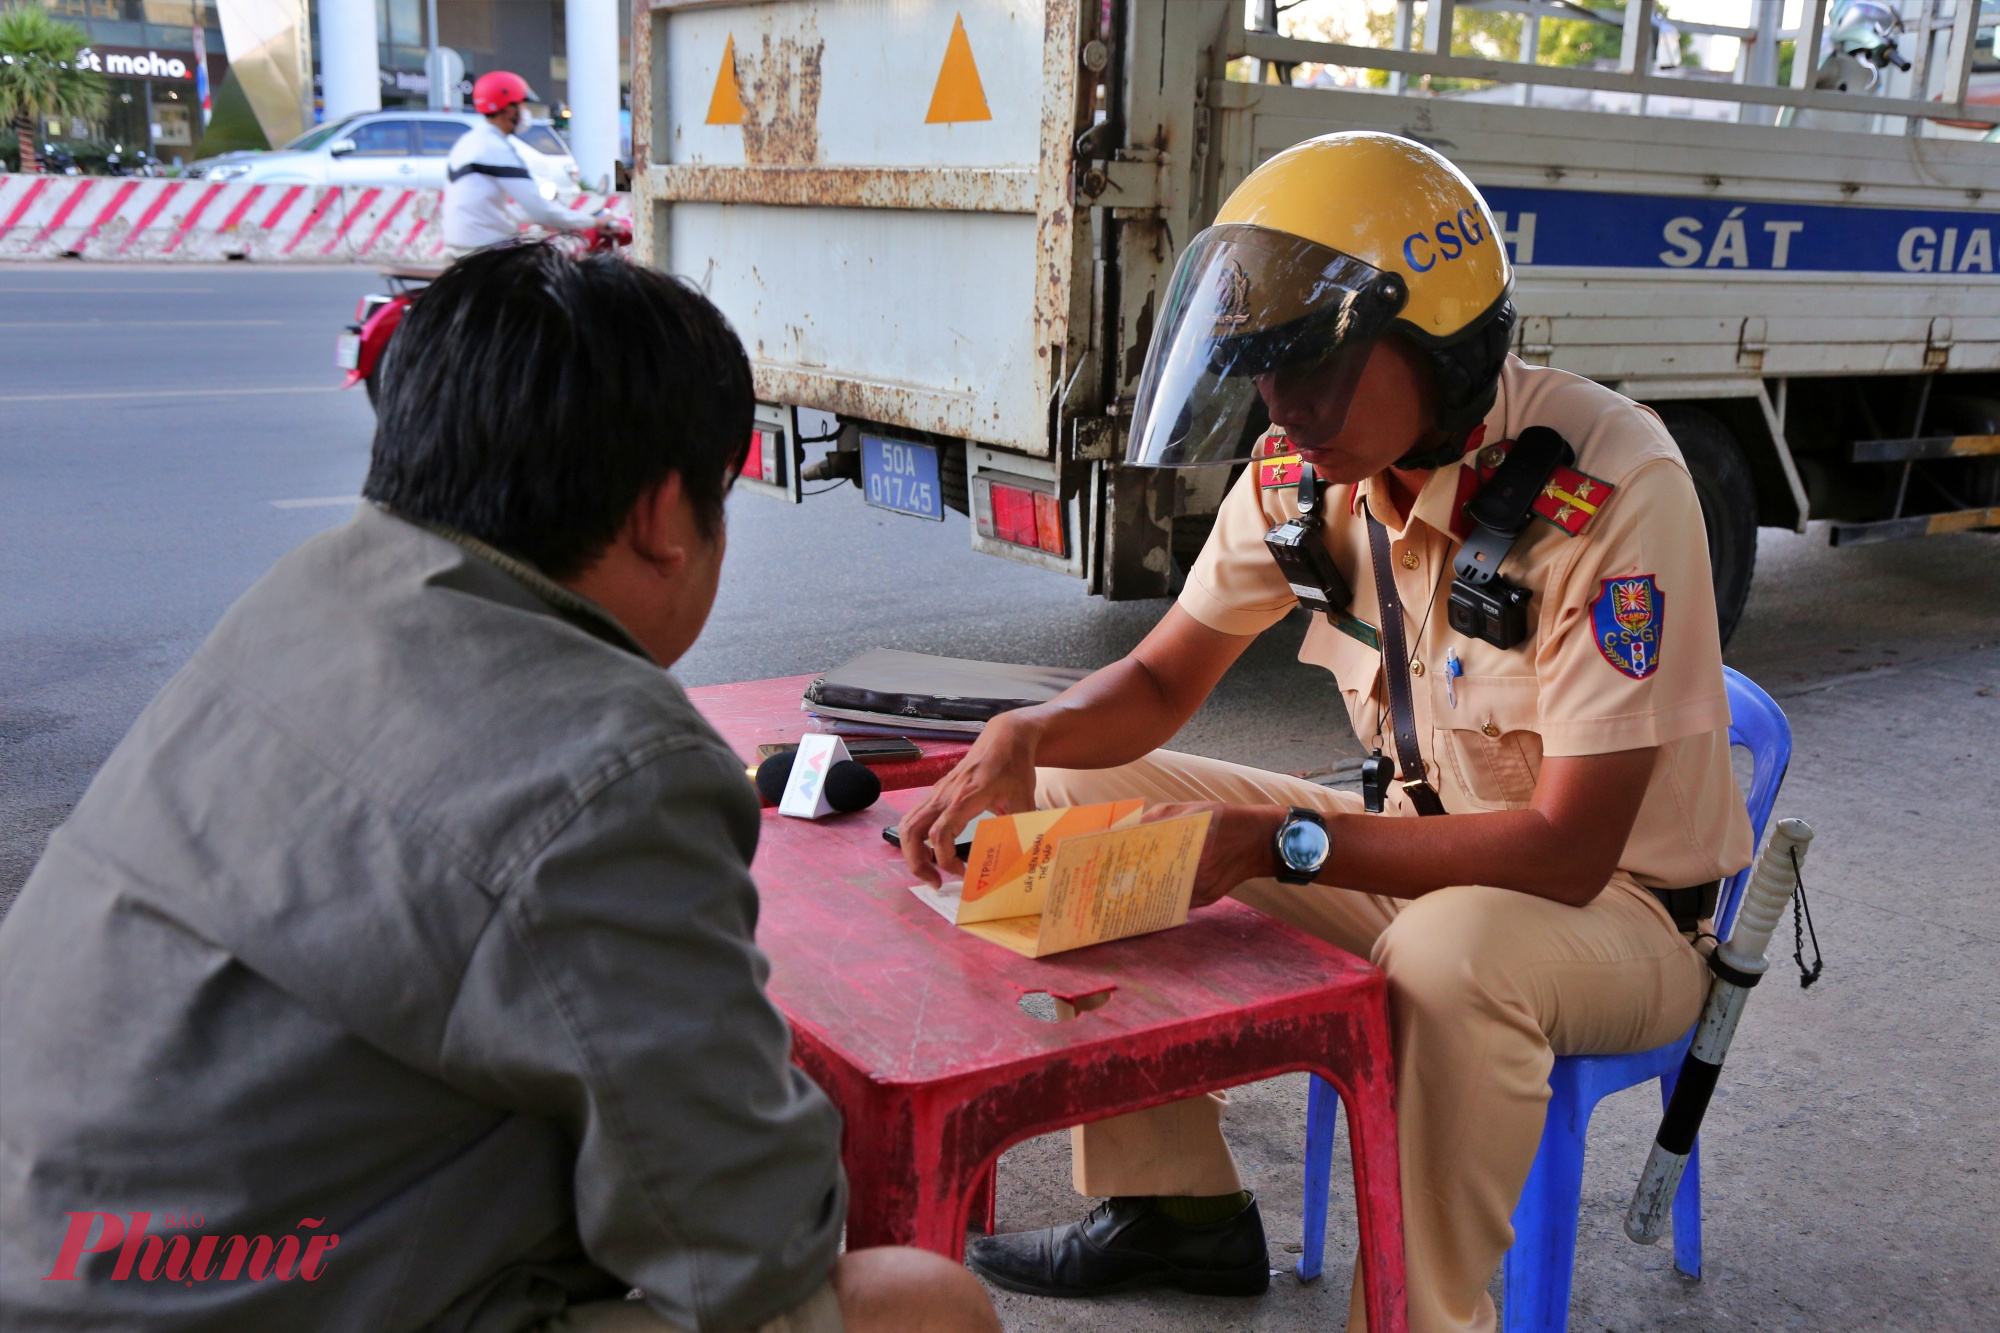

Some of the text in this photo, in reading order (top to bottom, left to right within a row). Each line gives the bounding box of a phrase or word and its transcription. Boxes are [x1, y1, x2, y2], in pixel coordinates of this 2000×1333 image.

[1659, 206, 1804, 269] SÁT
[1897, 226, 2000, 273] GIA
[881, 442, 916, 477] 50A
[870, 473, 932, 513] 017.45
